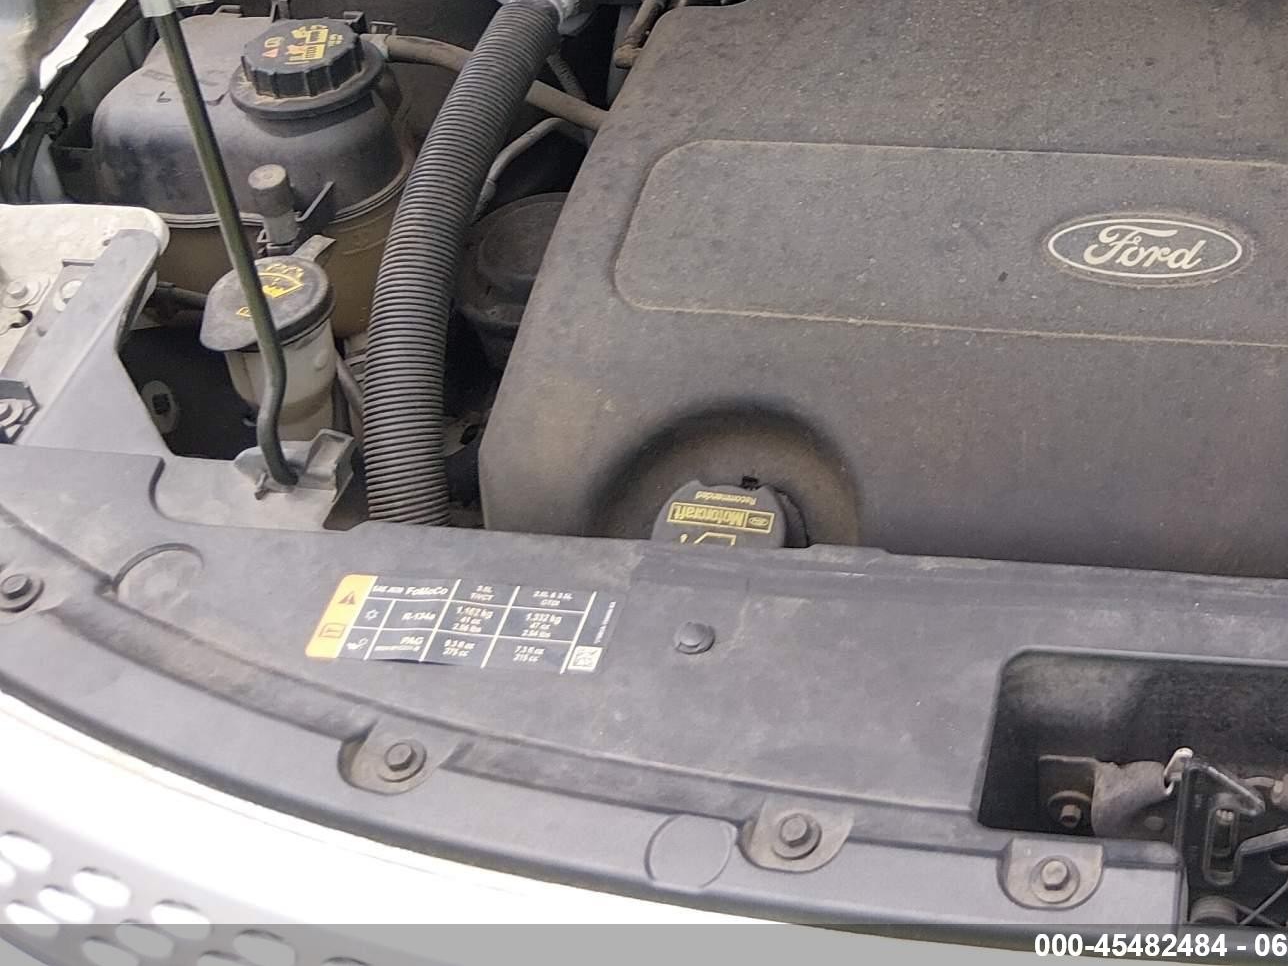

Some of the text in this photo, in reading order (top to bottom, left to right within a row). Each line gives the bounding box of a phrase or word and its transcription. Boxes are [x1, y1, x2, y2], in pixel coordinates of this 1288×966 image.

[1084, 224, 1207, 270] Ford
[695, 490, 757, 506] Recommended
[673, 504, 746, 526] Motorcraft
